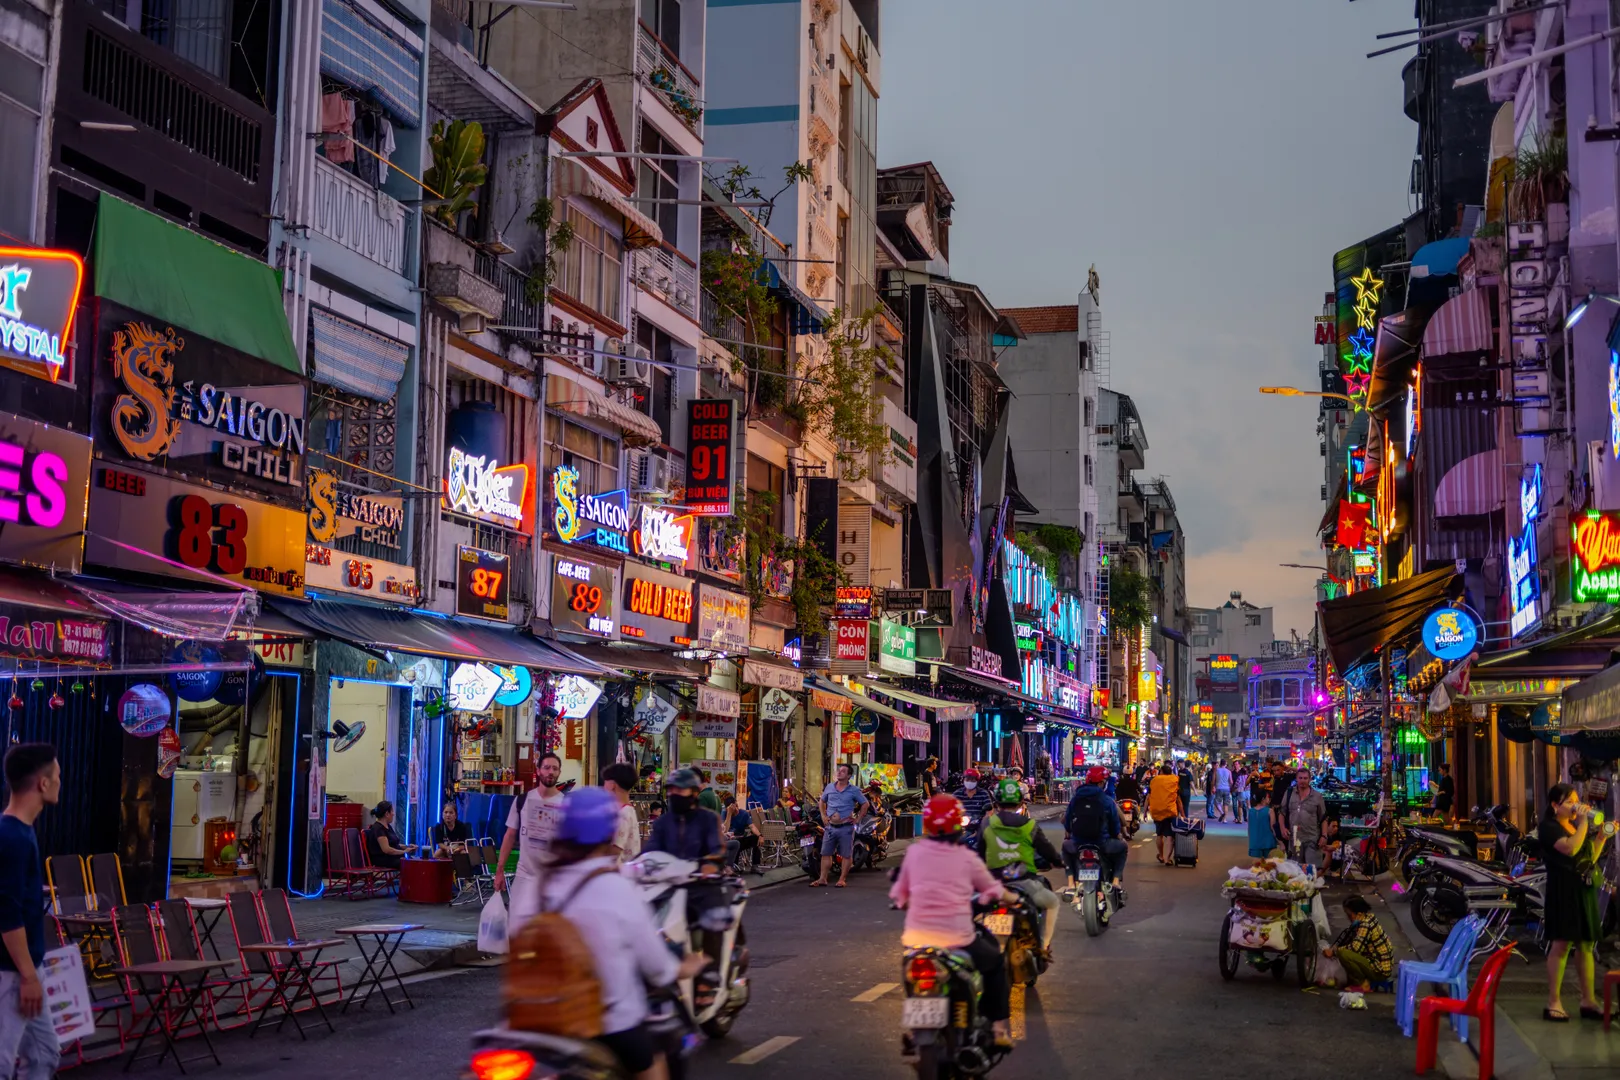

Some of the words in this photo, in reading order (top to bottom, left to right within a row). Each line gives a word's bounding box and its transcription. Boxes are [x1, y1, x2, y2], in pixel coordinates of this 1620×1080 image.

[181, 380, 194, 420] BIA
[693, 403, 729, 419] COLD
[199, 384, 305, 455] SAIGON
[692, 424, 728, 440] BEER
[223, 441, 302, 487] CHILL
[691, 445, 727, 481] 91
[105, 469, 147, 496] BEER
[465, 455, 513, 513] Tiger
[687, 484, 704, 499] BÙI
[706, 484, 728, 500] VIỆN
[350, 495, 404, 531] SAIGON
[586, 494, 629, 532] SAIGON
[179, 495, 249, 575] 83
[361, 527, 401, 549] CHILL
[596, 527, 629, 554] CHILL
[348, 559, 373, 590] 85
[473, 568, 503, 599] 87
[572, 583, 602, 613] 89
[630, 577, 662, 617] COLD
[663, 585, 693, 624] BEER
[837, 588, 871, 599] TATTOO
[840, 623, 865, 639] CÒN
[1434, 635, 1464, 643] SAIGON
[838, 641, 865, 657] PHÒNG
[176, 672, 206, 681] SAIGON
[455, 682, 489, 700] Tiger
[558, 693, 588, 709] Tiger
[637, 710, 667, 726] Tiger
[764, 702, 789, 715] Tiger
